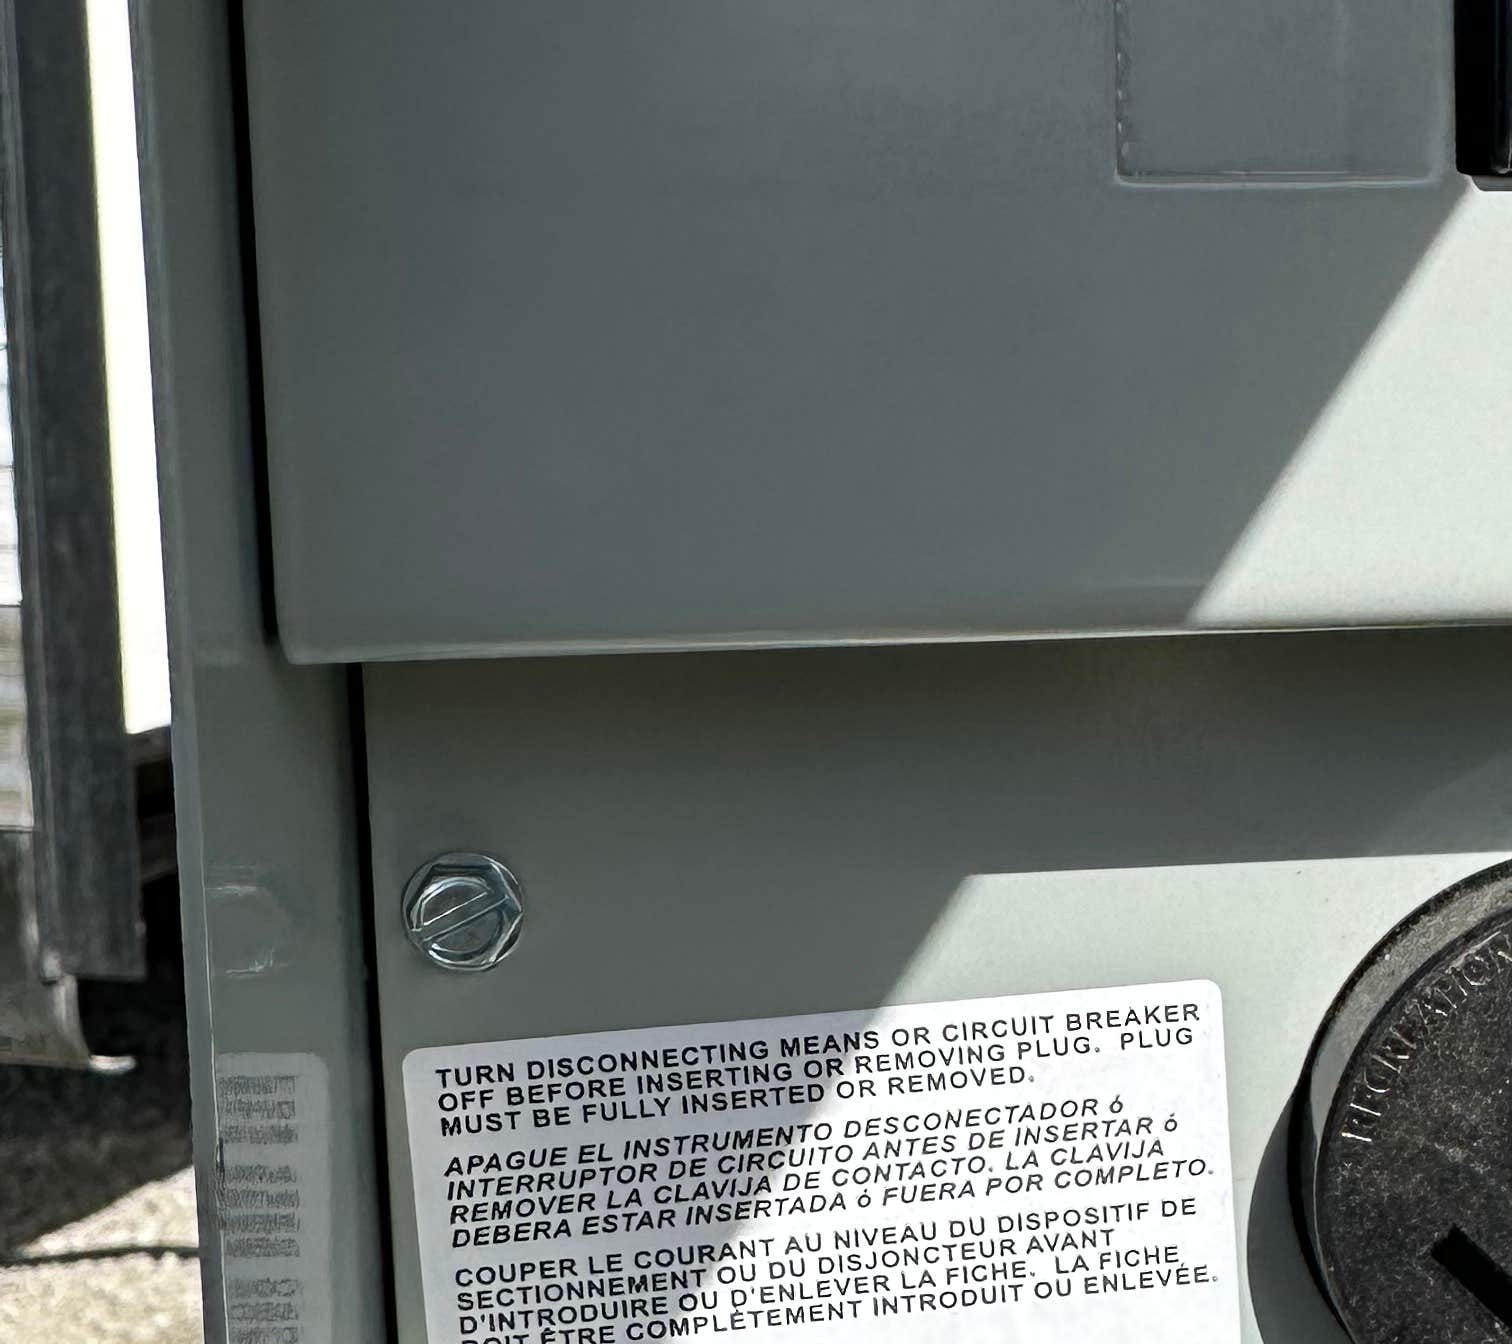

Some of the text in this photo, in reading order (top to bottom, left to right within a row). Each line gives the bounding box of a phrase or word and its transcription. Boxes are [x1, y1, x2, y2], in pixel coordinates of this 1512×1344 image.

[434, 1003, 1201, 1090] TURN DISCONNECTING MEANS OR CIRCUIT BREAKER
[437, 1027, 1193, 1113] OFF BEFORE INSERTING OR REMOVING PLUG. PLUG
[439, 1065, 1035, 1137] MUST BE FULLY INSERTED OR REMOVED.
[443, 1146, 569, 1178] APAGUE
[577, 1142, 614, 1165] EL
[623, 1122, 833, 1161] INSTRUMENTO
[843, 1098, 1099, 1139] DESCONECTADOR
[446, 1162, 658, 1202] INTERRUPTOR
[667, 1156, 708, 1180] DE
[717, 1144, 854, 1176] CIRCUITO
[861, 1134, 957, 1161] ANTES
[967, 1128, 1006, 1152] DE
[1014, 1116, 1154, 1148] INSERTAR
[449, 1138, 1164, 1226] REMOVER LA CLAVIJA DE CONTACTO. LA CLAVIJA
[451, 1218, 572, 1249] DEBERA
[581, 1208, 677, 1236] ESTAR
[685, 1191, 847, 1227] INSERTADA
[881, 1179, 976, 1207] FUERA
[985, 1173, 1044, 1197] POR
[1053, 1158, 1214, 1190] COMPLETO.
[454, 1197, 1197, 1289] COUPER LE COURANT AU NIVEAU DU DISPOSITIF DE
[456, 1227, 1116, 1312] SECTIONNEMENT OU DU DISJONCTEUR AVANT
[458, 1244, 1180, 1336] D'INTRODUIRE OU D'ENLEVER LA FICHE. LA FICHE
[872, 1283, 1025, 1318] INTRODUIT
[1033, 1277, 1072, 1300] OU
[1083, 1262, 1219, 1295] ENLEVÉE.
